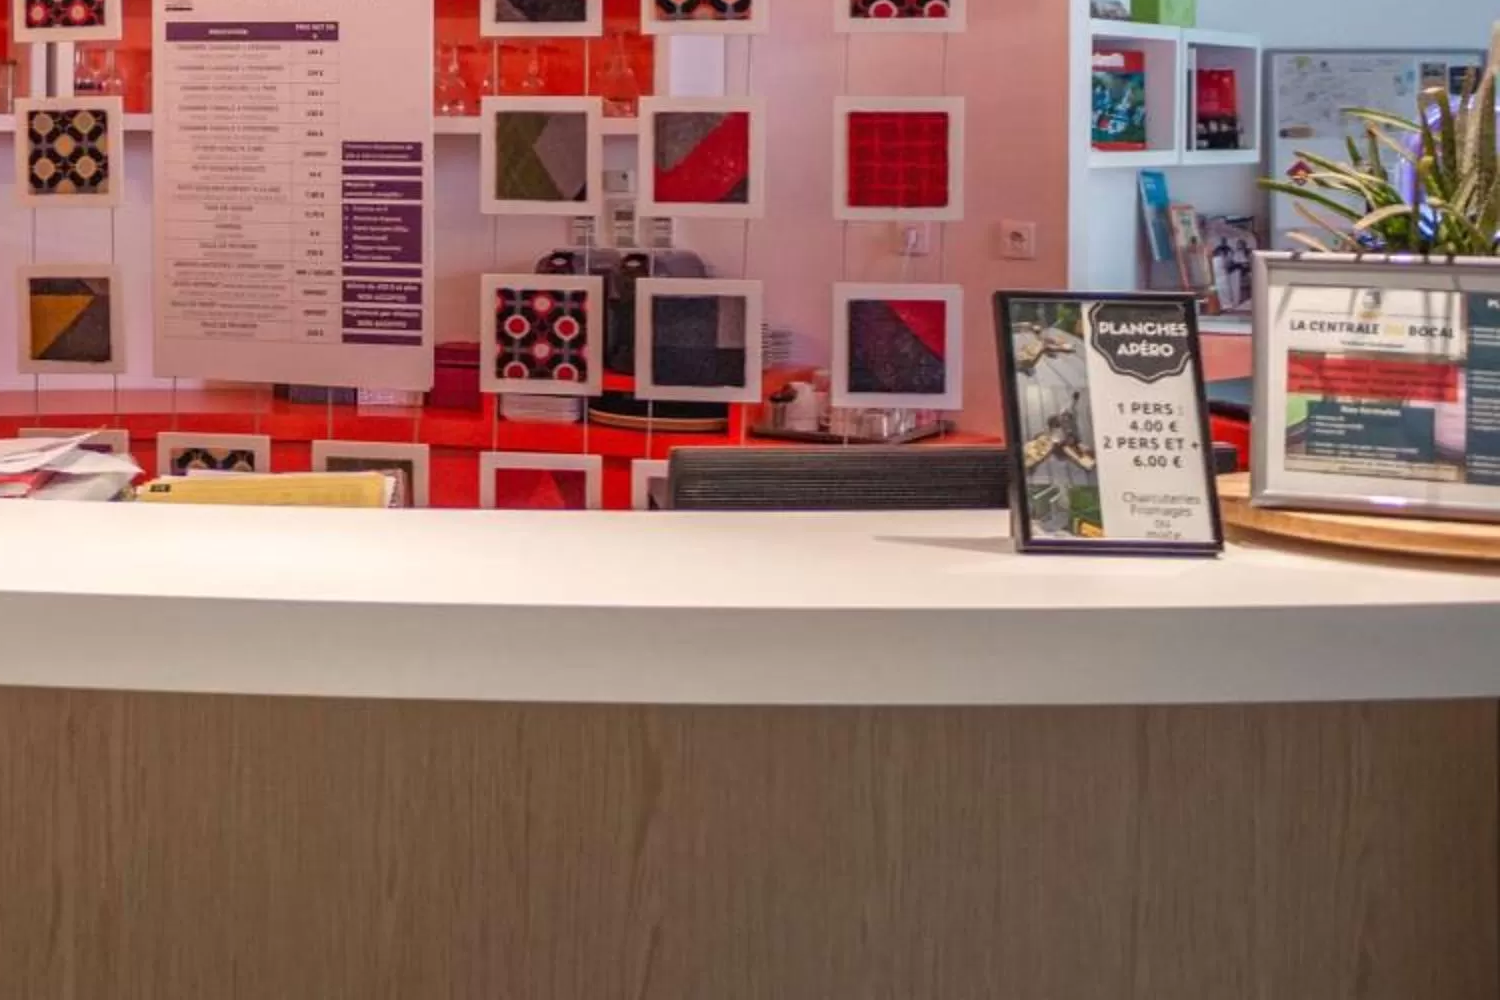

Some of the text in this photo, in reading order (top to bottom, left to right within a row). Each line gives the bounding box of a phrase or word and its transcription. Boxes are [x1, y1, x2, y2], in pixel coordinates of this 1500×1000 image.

[1100, 321, 1188, 337] PLANCHES
[1289, 320, 1306, 331] LA
[1309, 320, 1380, 335] CENTRALE
[1408, 325, 1454, 339] BOCAL
[1117, 340, 1175, 357] APÉRO
[1118, 402, 1124, 415] 1
[1131, 402, 1173, 415] PERS
[1130, 420, 1179, 433] 4.00 €
[1103, 436, 1112, 449] 2
[1117, 437, 1159, 450] PERS
[1165, 438, 1184, 450] ET
[1133, 455, 1184, 469] 6.00 €
